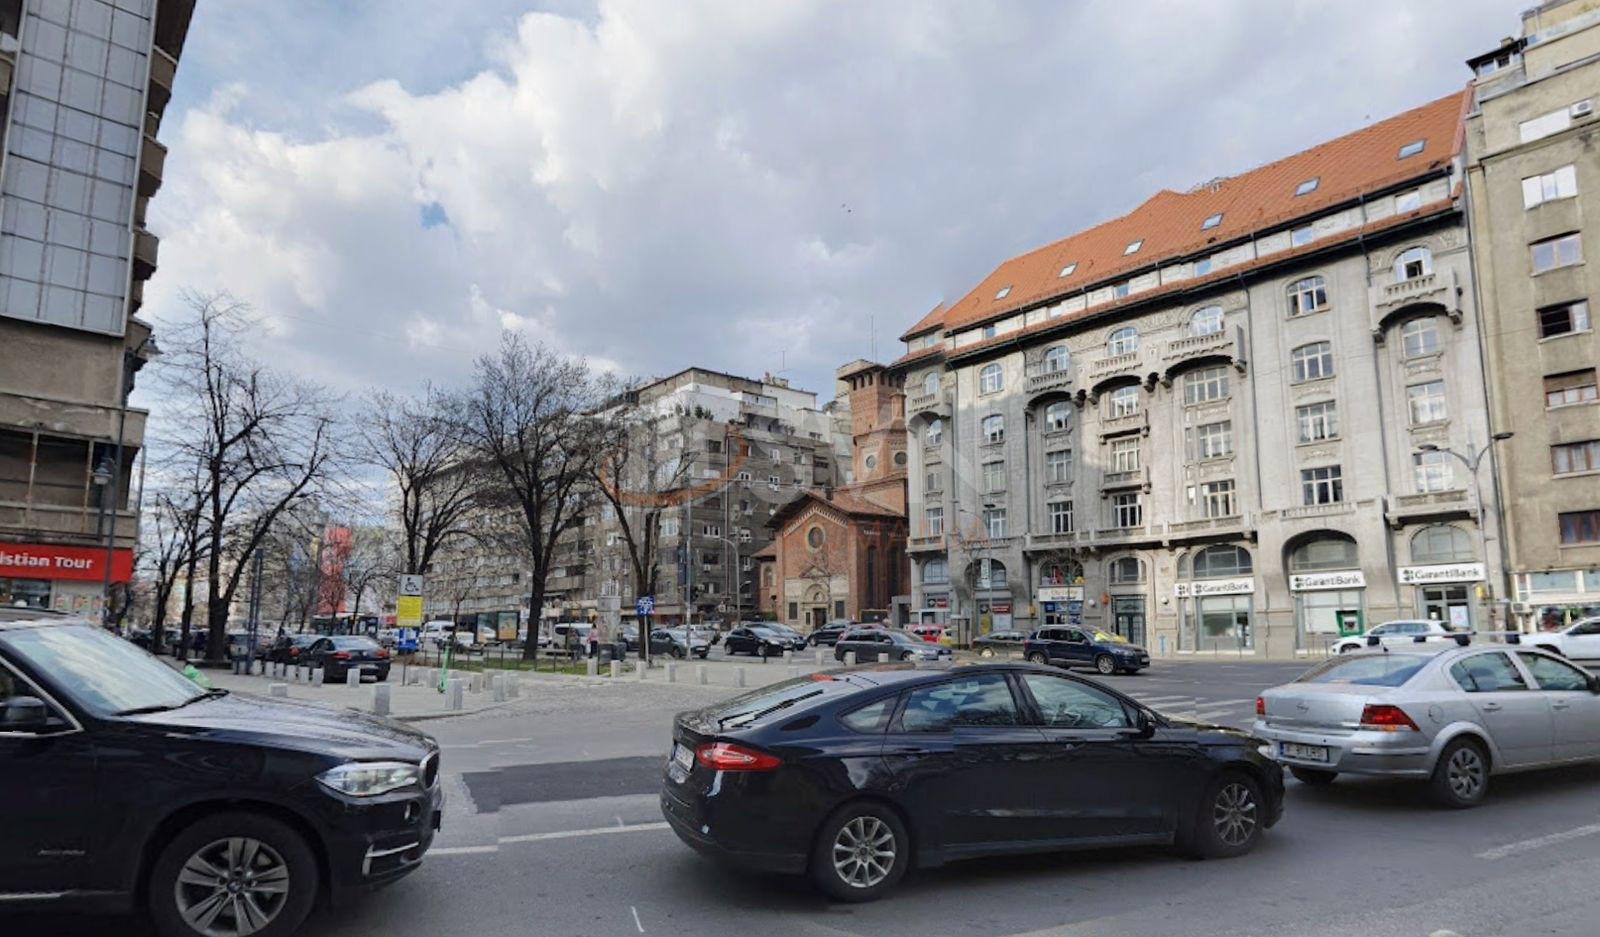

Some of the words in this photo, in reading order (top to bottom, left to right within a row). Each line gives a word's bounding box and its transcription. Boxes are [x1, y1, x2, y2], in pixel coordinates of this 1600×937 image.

[54, 556, 94, 569] Tour
[1415, 567, 1480, 579] GarantiBank
[1305, 575, 1361, 586] GarantiBank
[1202, 582, 1250, 593] GarantiBank
